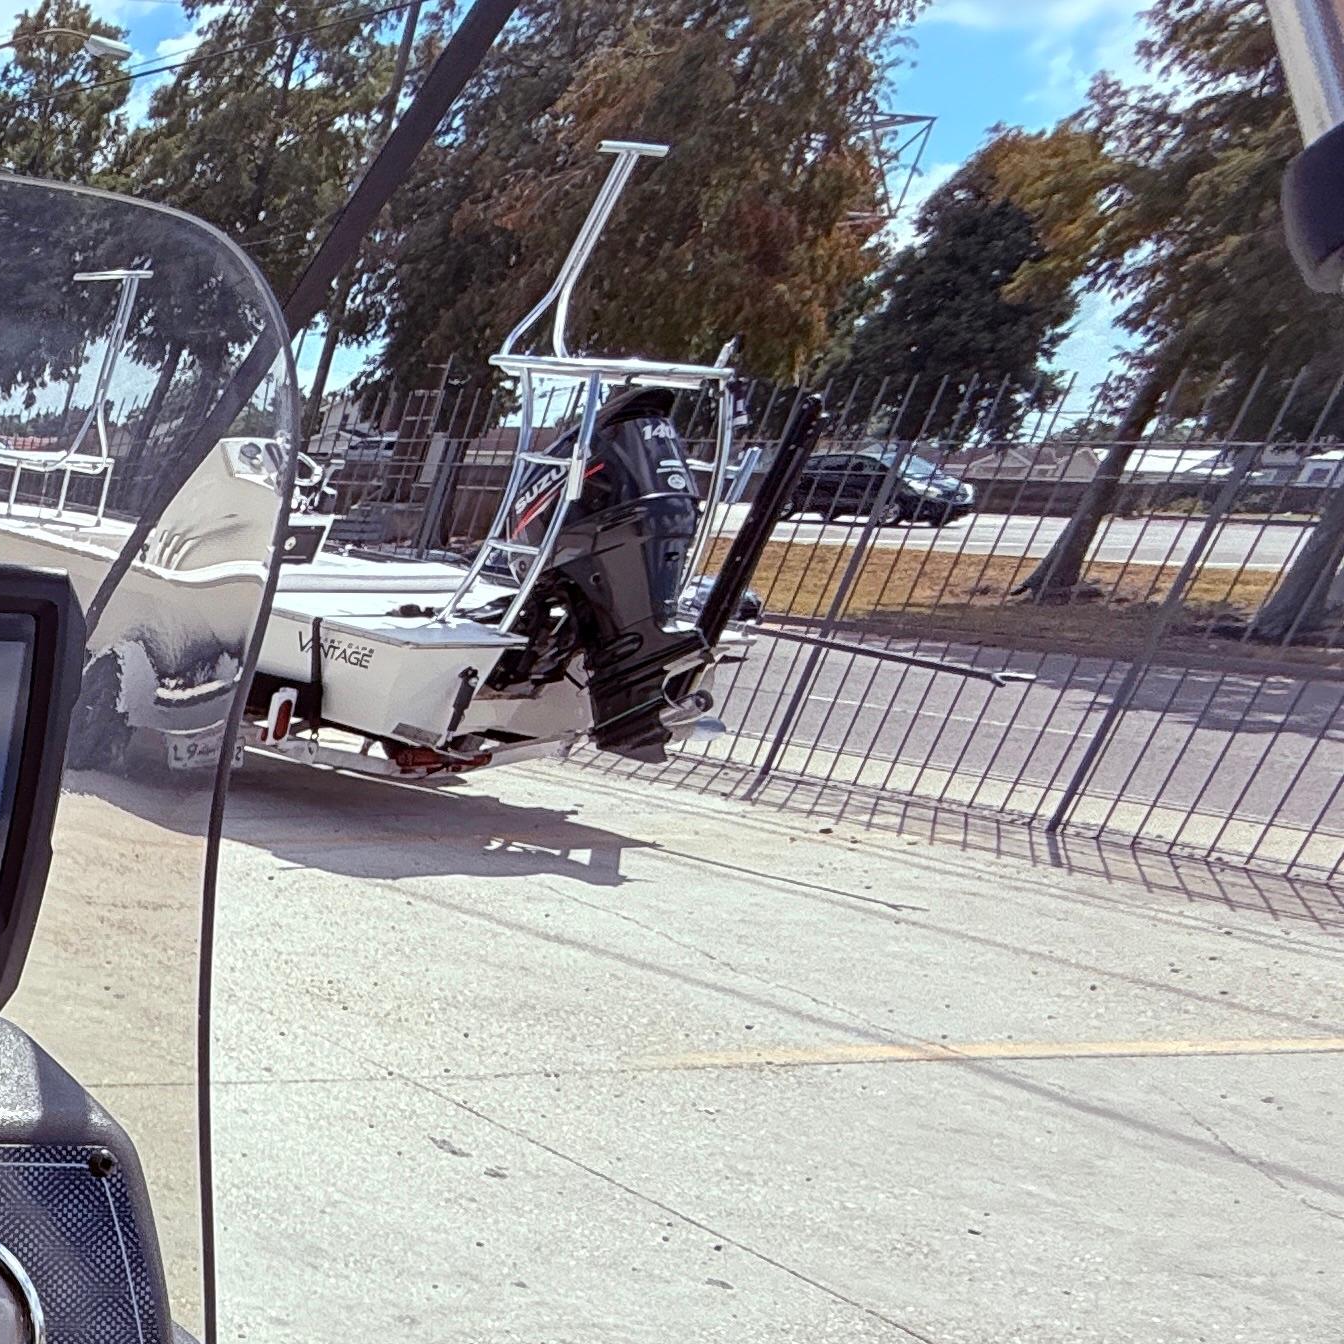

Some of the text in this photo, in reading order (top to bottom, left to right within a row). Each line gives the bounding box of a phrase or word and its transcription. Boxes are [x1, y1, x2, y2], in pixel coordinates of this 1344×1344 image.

[642, 423, 676, 440] 140
[514, 466, 569, 515] SUZU
[298, 631, 373, 669] VNTAGE
